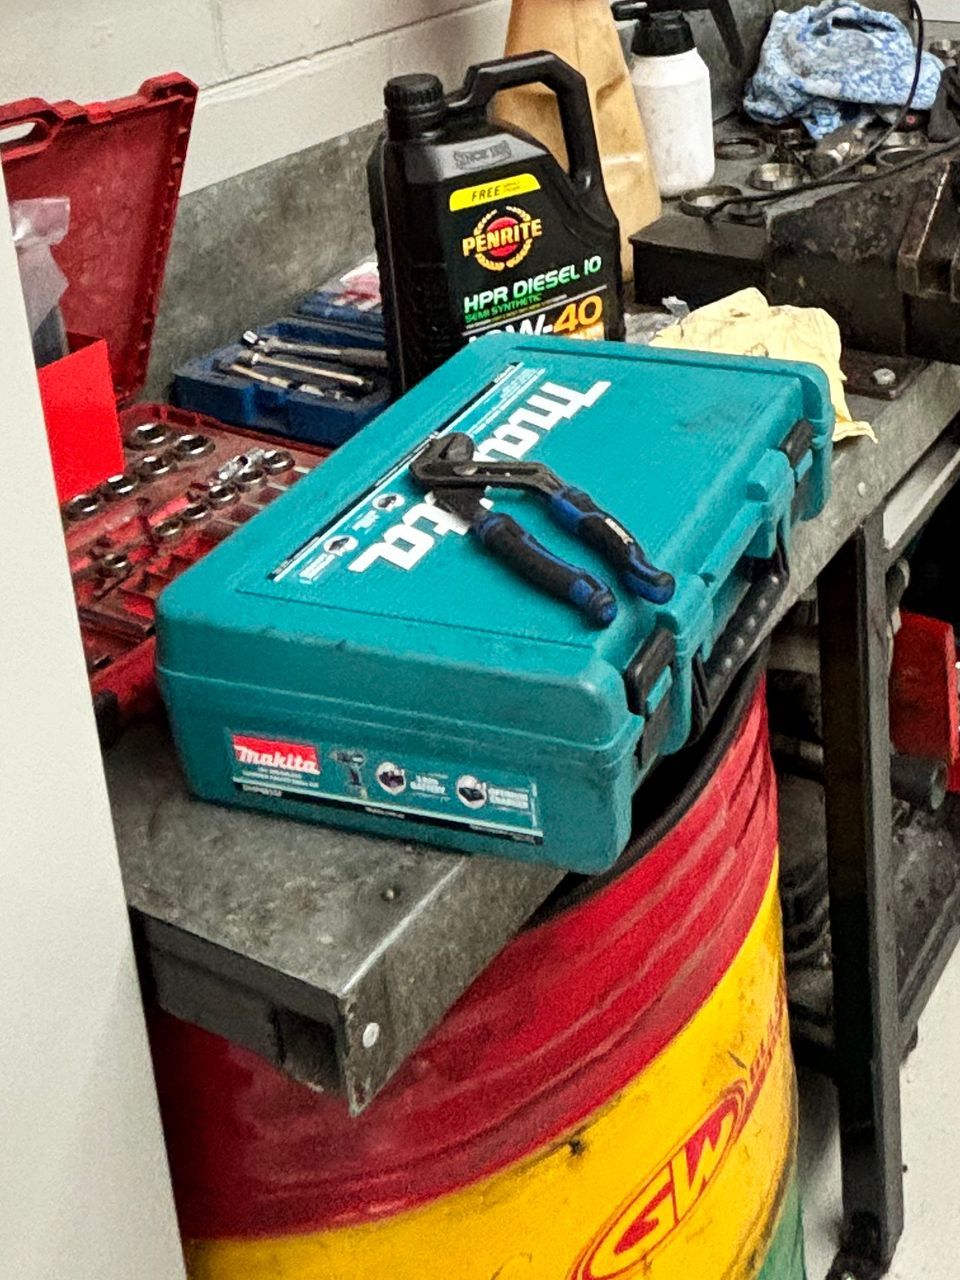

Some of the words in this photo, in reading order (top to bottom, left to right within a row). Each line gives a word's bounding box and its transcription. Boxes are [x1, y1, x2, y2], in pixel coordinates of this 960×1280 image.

[471, 185, 501, 202] FREE
[462, 218, 543, 257] PENRITE
[464, 285, 509, 314] HPR
[512, 263, 581, 299] DIESEL
